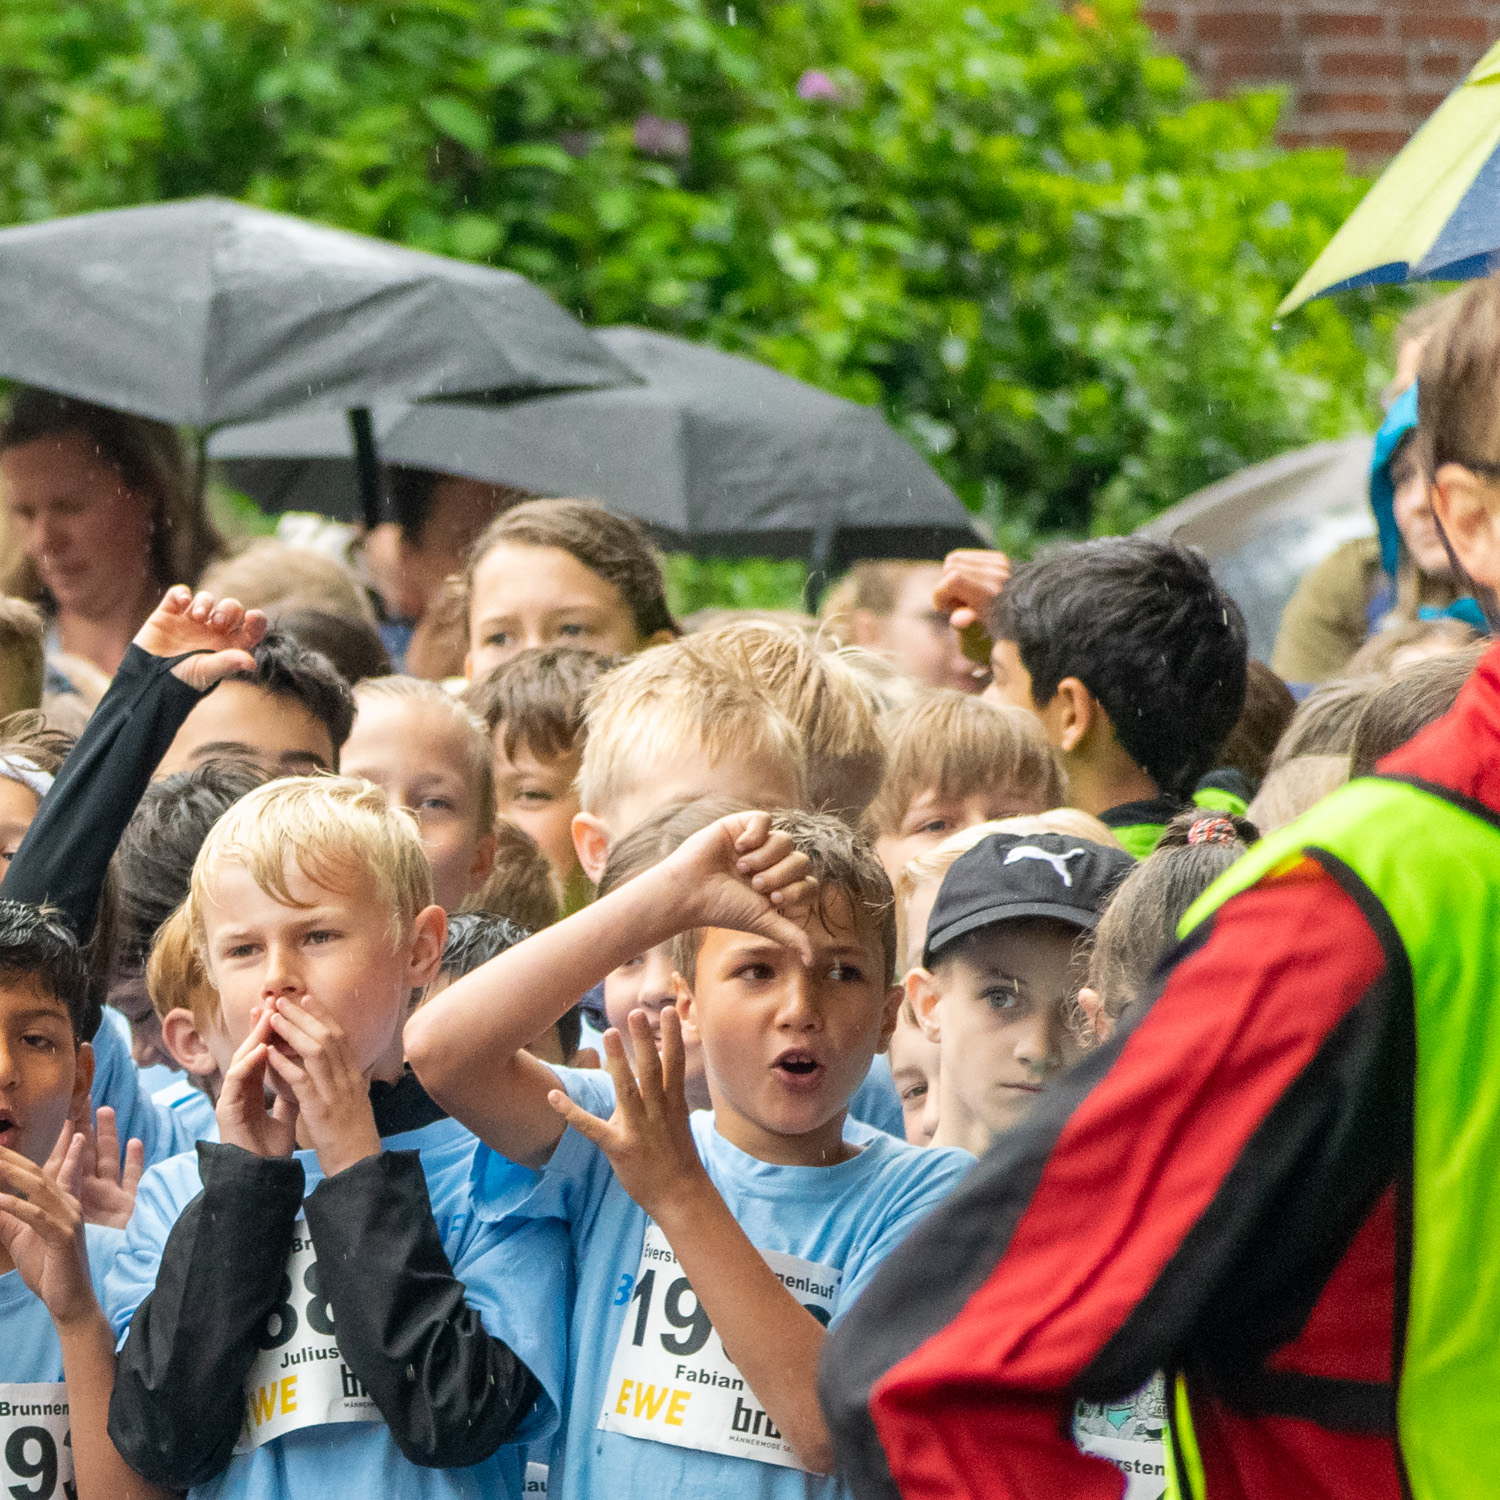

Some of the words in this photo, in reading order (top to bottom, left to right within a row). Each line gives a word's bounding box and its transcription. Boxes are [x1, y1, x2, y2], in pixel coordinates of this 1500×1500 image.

[280, 1346, 340, 1369] Julius
[675, 1364, 744, 1391] Fabian
[250, 1375, 297, 1427] WE
[616, 1379, 692, 1427] EWE
